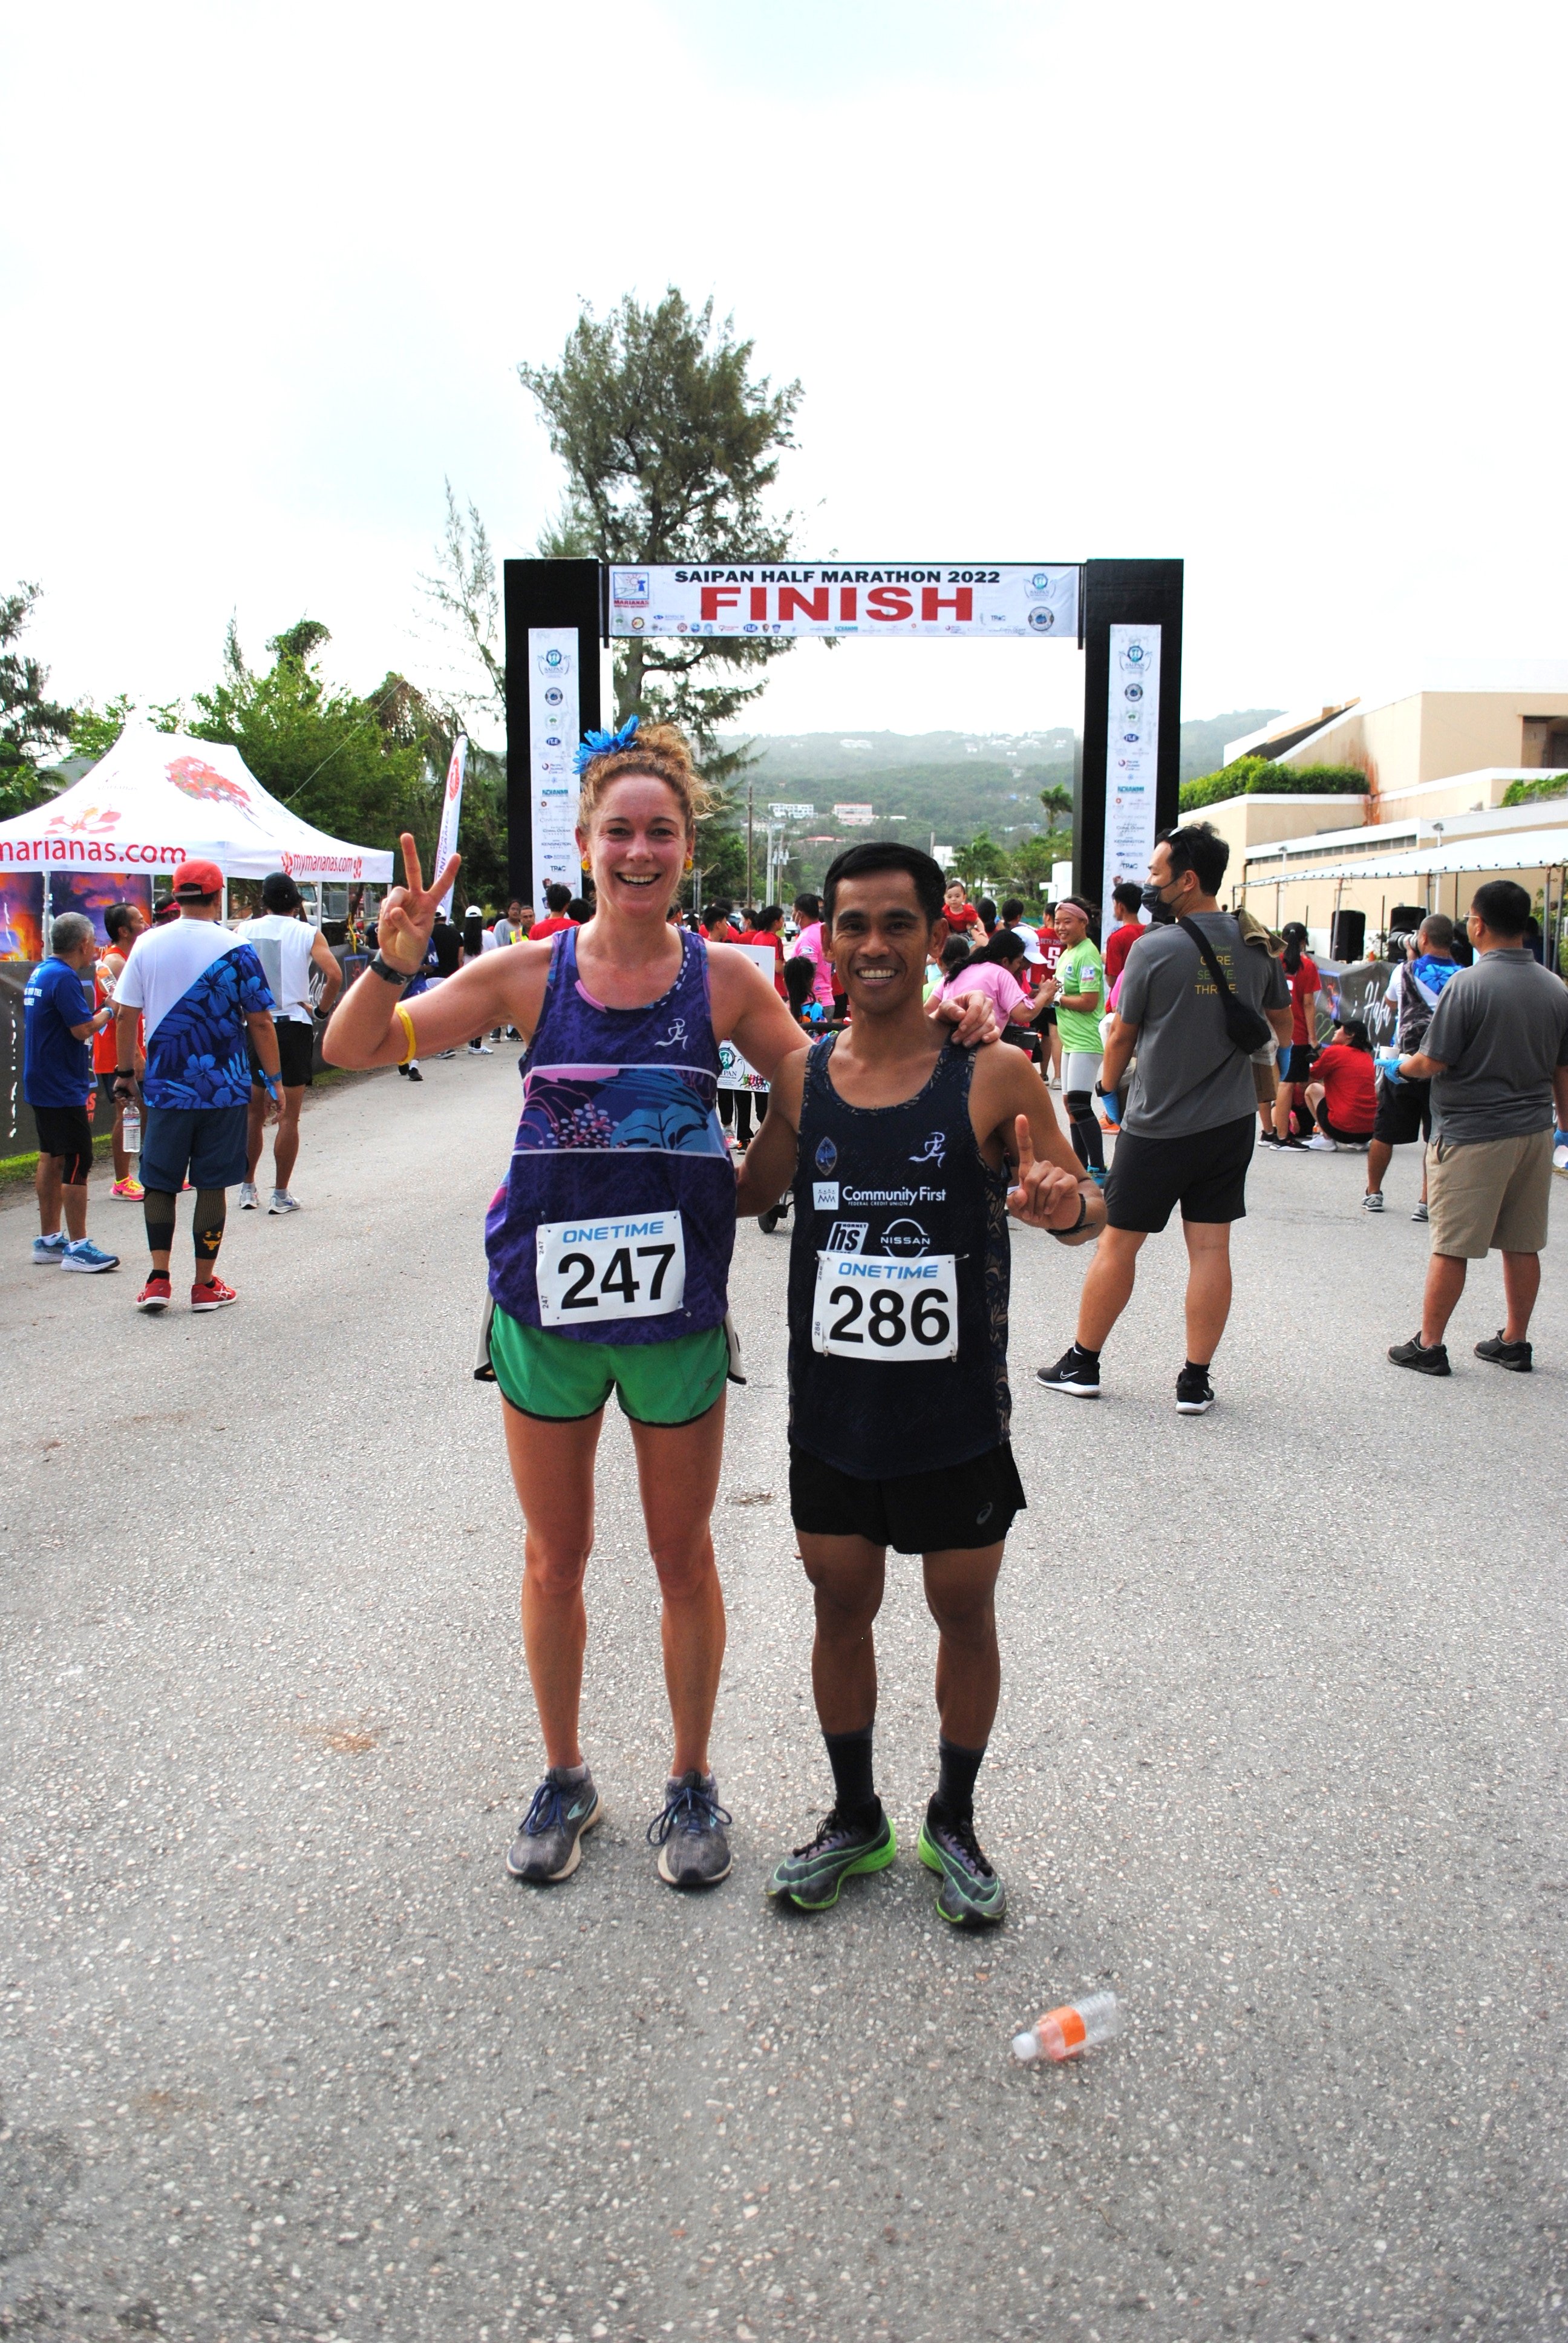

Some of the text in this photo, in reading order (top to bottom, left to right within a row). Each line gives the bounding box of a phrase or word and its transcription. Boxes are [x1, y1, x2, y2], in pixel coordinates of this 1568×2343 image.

[675, 571, 1000, 583] SAIPAN HALF MARATHON 2022
[701, 586, 973, 621] FINISH
[293, 853, 353, 877] mymarianas.com
[1047, 946, 1061, 969] 5
[1200, 955, 1234, 965] CRE.
[1197, 969, 1237, 980] SEE.
[1194, 984, 1239, 994] THRE.
[842, 1185, 946, 1206] Community First
[563, 1221, 664, 1244] ONETIME
[880, 1237, 930, 1245] NISSAN
[558, 1244, 676, 1310] 247
[838, 1262, 939, 1280] ONETIME
[829, 1285, 950, 1347] 286
